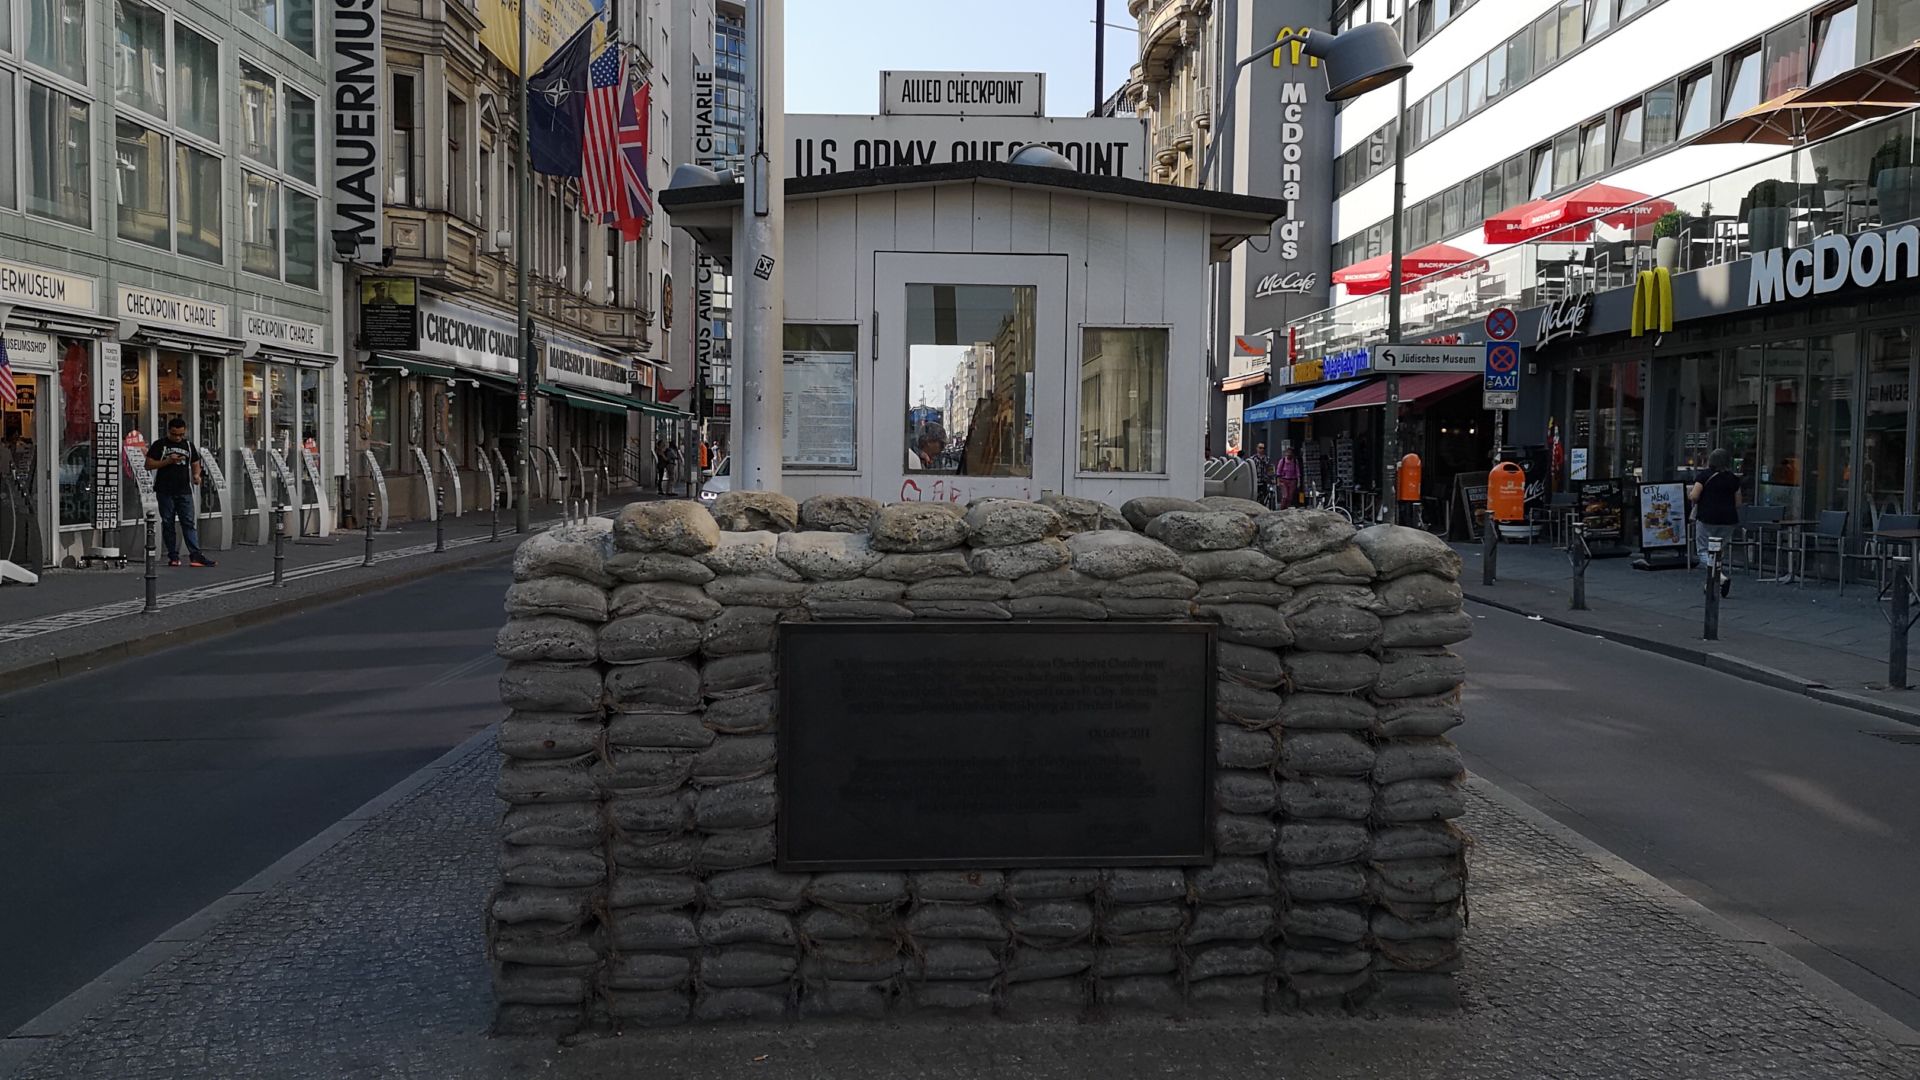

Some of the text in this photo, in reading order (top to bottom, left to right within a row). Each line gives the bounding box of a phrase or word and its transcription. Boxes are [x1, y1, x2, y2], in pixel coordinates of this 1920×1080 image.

[902, 79, 1023, 104] ALLIED CHECKPOINT
[696, 72, 712, 153] CHARLIE
[1281, 83, 1307, 260] McDonald's
[1748, 224, 1919, 305] McDon
[2, 268, 65, 301] ERMUSEUM
[126, 292, 217, 328] CHECKPOINT CHARLIE
[5, 337, 47, 353] USEUMSSHOP
[248, 317, 314, 345] CHECKPOINT CHARLIE
[427, 313, 487, 353] CHECKPOINT
[1400, 351, 1476, 364] Jüdisches Museum
[1487, 375, 1516, 387] TAXI
